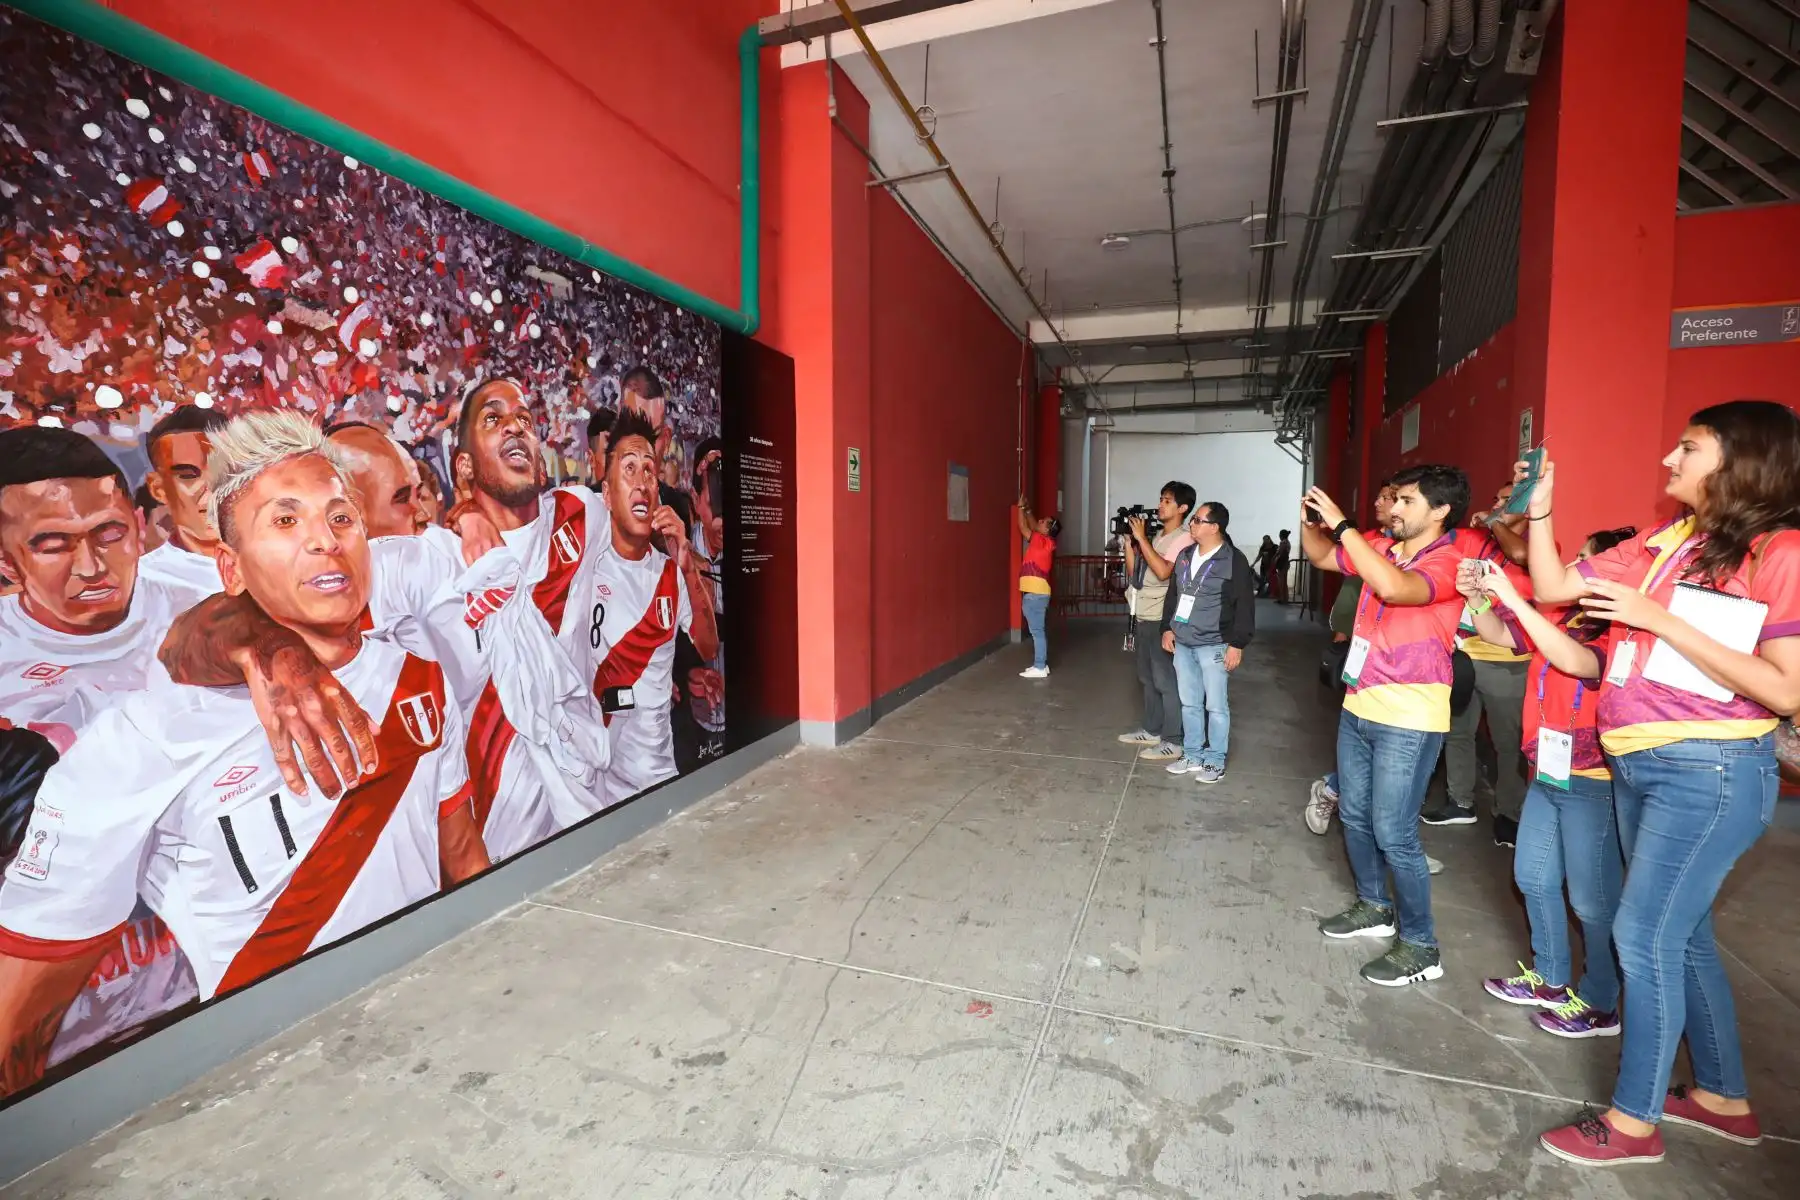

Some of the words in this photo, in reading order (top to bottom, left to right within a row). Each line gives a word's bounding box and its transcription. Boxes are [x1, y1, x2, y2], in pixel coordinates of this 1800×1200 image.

[1681, 317, 1734, 329] Acceso
[1681, 329, 1758, 342] Preferente
[589, 602, 605, 650] 8
[219, 782, 257, 803] umbro
